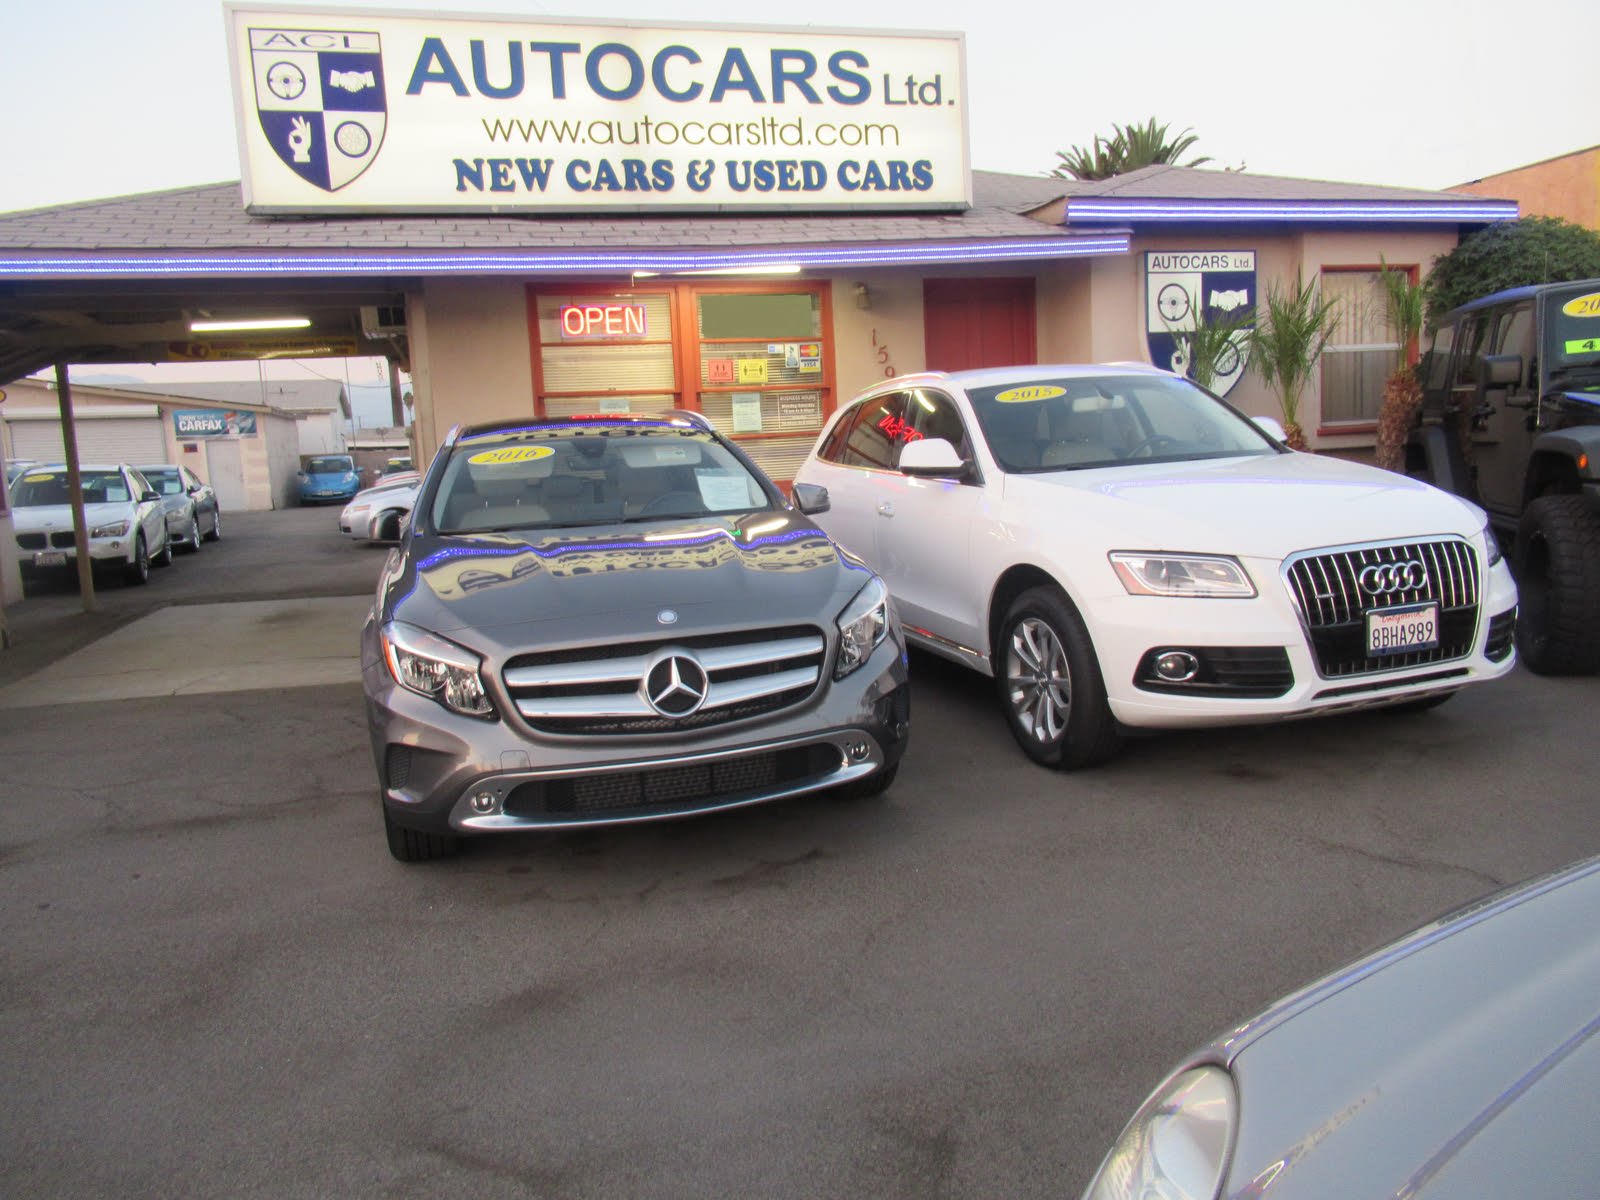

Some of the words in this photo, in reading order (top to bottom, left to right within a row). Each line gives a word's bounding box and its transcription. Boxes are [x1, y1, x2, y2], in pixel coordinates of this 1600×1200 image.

[264, 33, 372, 48] ACL
[405, 37, 872, 106] AUTOCARS
[883, 74, 955, 106] Ltd.
[481, 115, 899, 146] www.autocarsltd.com
[452, 158, 554, 192] NEW
[565, 158, 675, 192] CARS
[686, 159, 716, 192] &
[725, 160, 828, 192] USED
[837, 160, 934, 192] CARS
[1152, 255, 1229, 269] AUTOCARS
[1234, 257, 1252, 269] Ltd.
[564, 307, 644, 335] OPEN
[179, 420, 222, 431] CARFAX
[1372, 621, 1433, 648] 8BHA989
